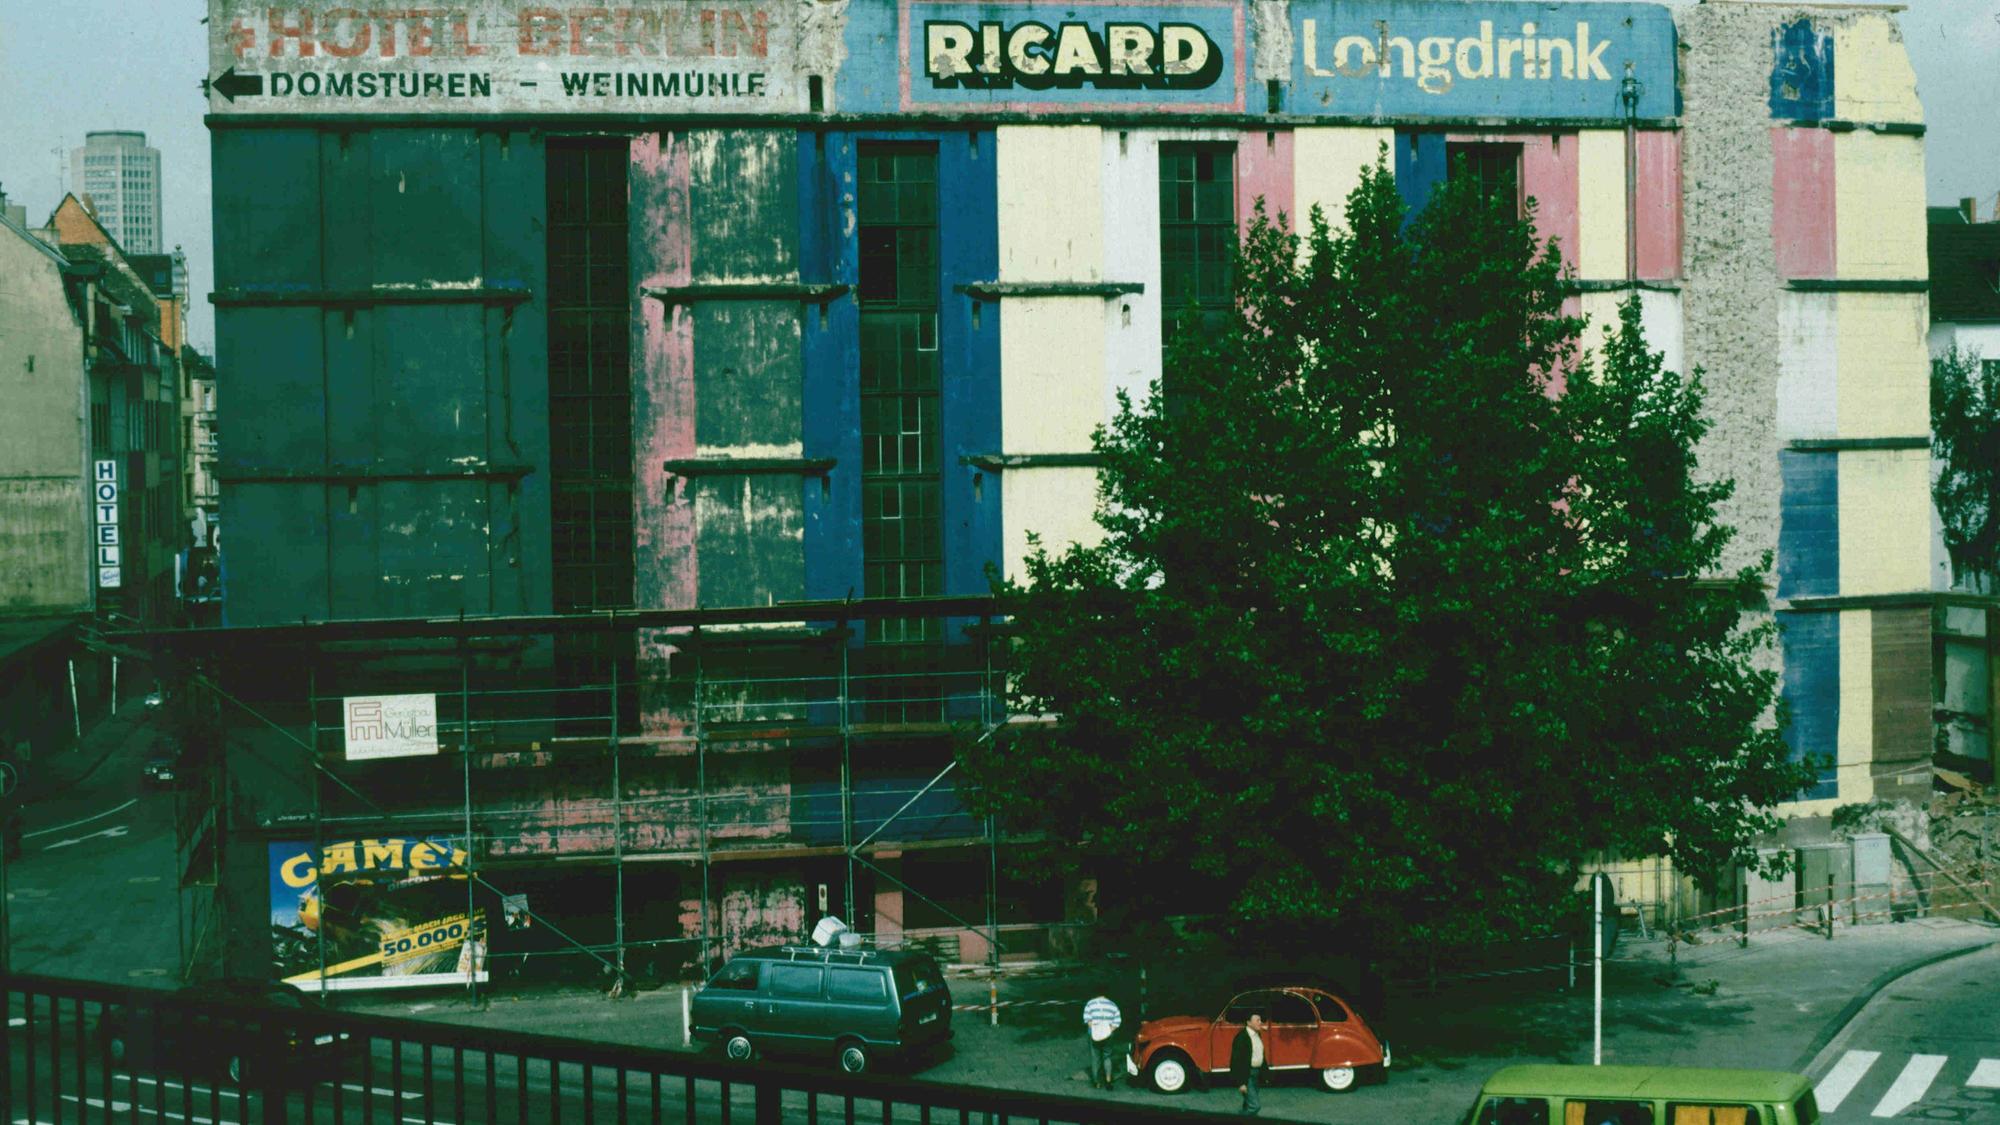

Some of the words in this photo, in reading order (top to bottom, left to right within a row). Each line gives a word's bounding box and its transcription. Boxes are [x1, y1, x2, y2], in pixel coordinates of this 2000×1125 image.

[267, 6, 489, 58] HOTEL
[517, 7, 768, 58] BERLIN
[925, 22, 1214, 82] RICARD
[1302, 18, 1613, 95] Longdrink
[270, 72, 491, 98] DOMSTUBEN
[560, 70, 767, 97] WEINMÜHLE
[98, 462, 116, 565] HOTEL
[384, 717, 434, 740] Müller
